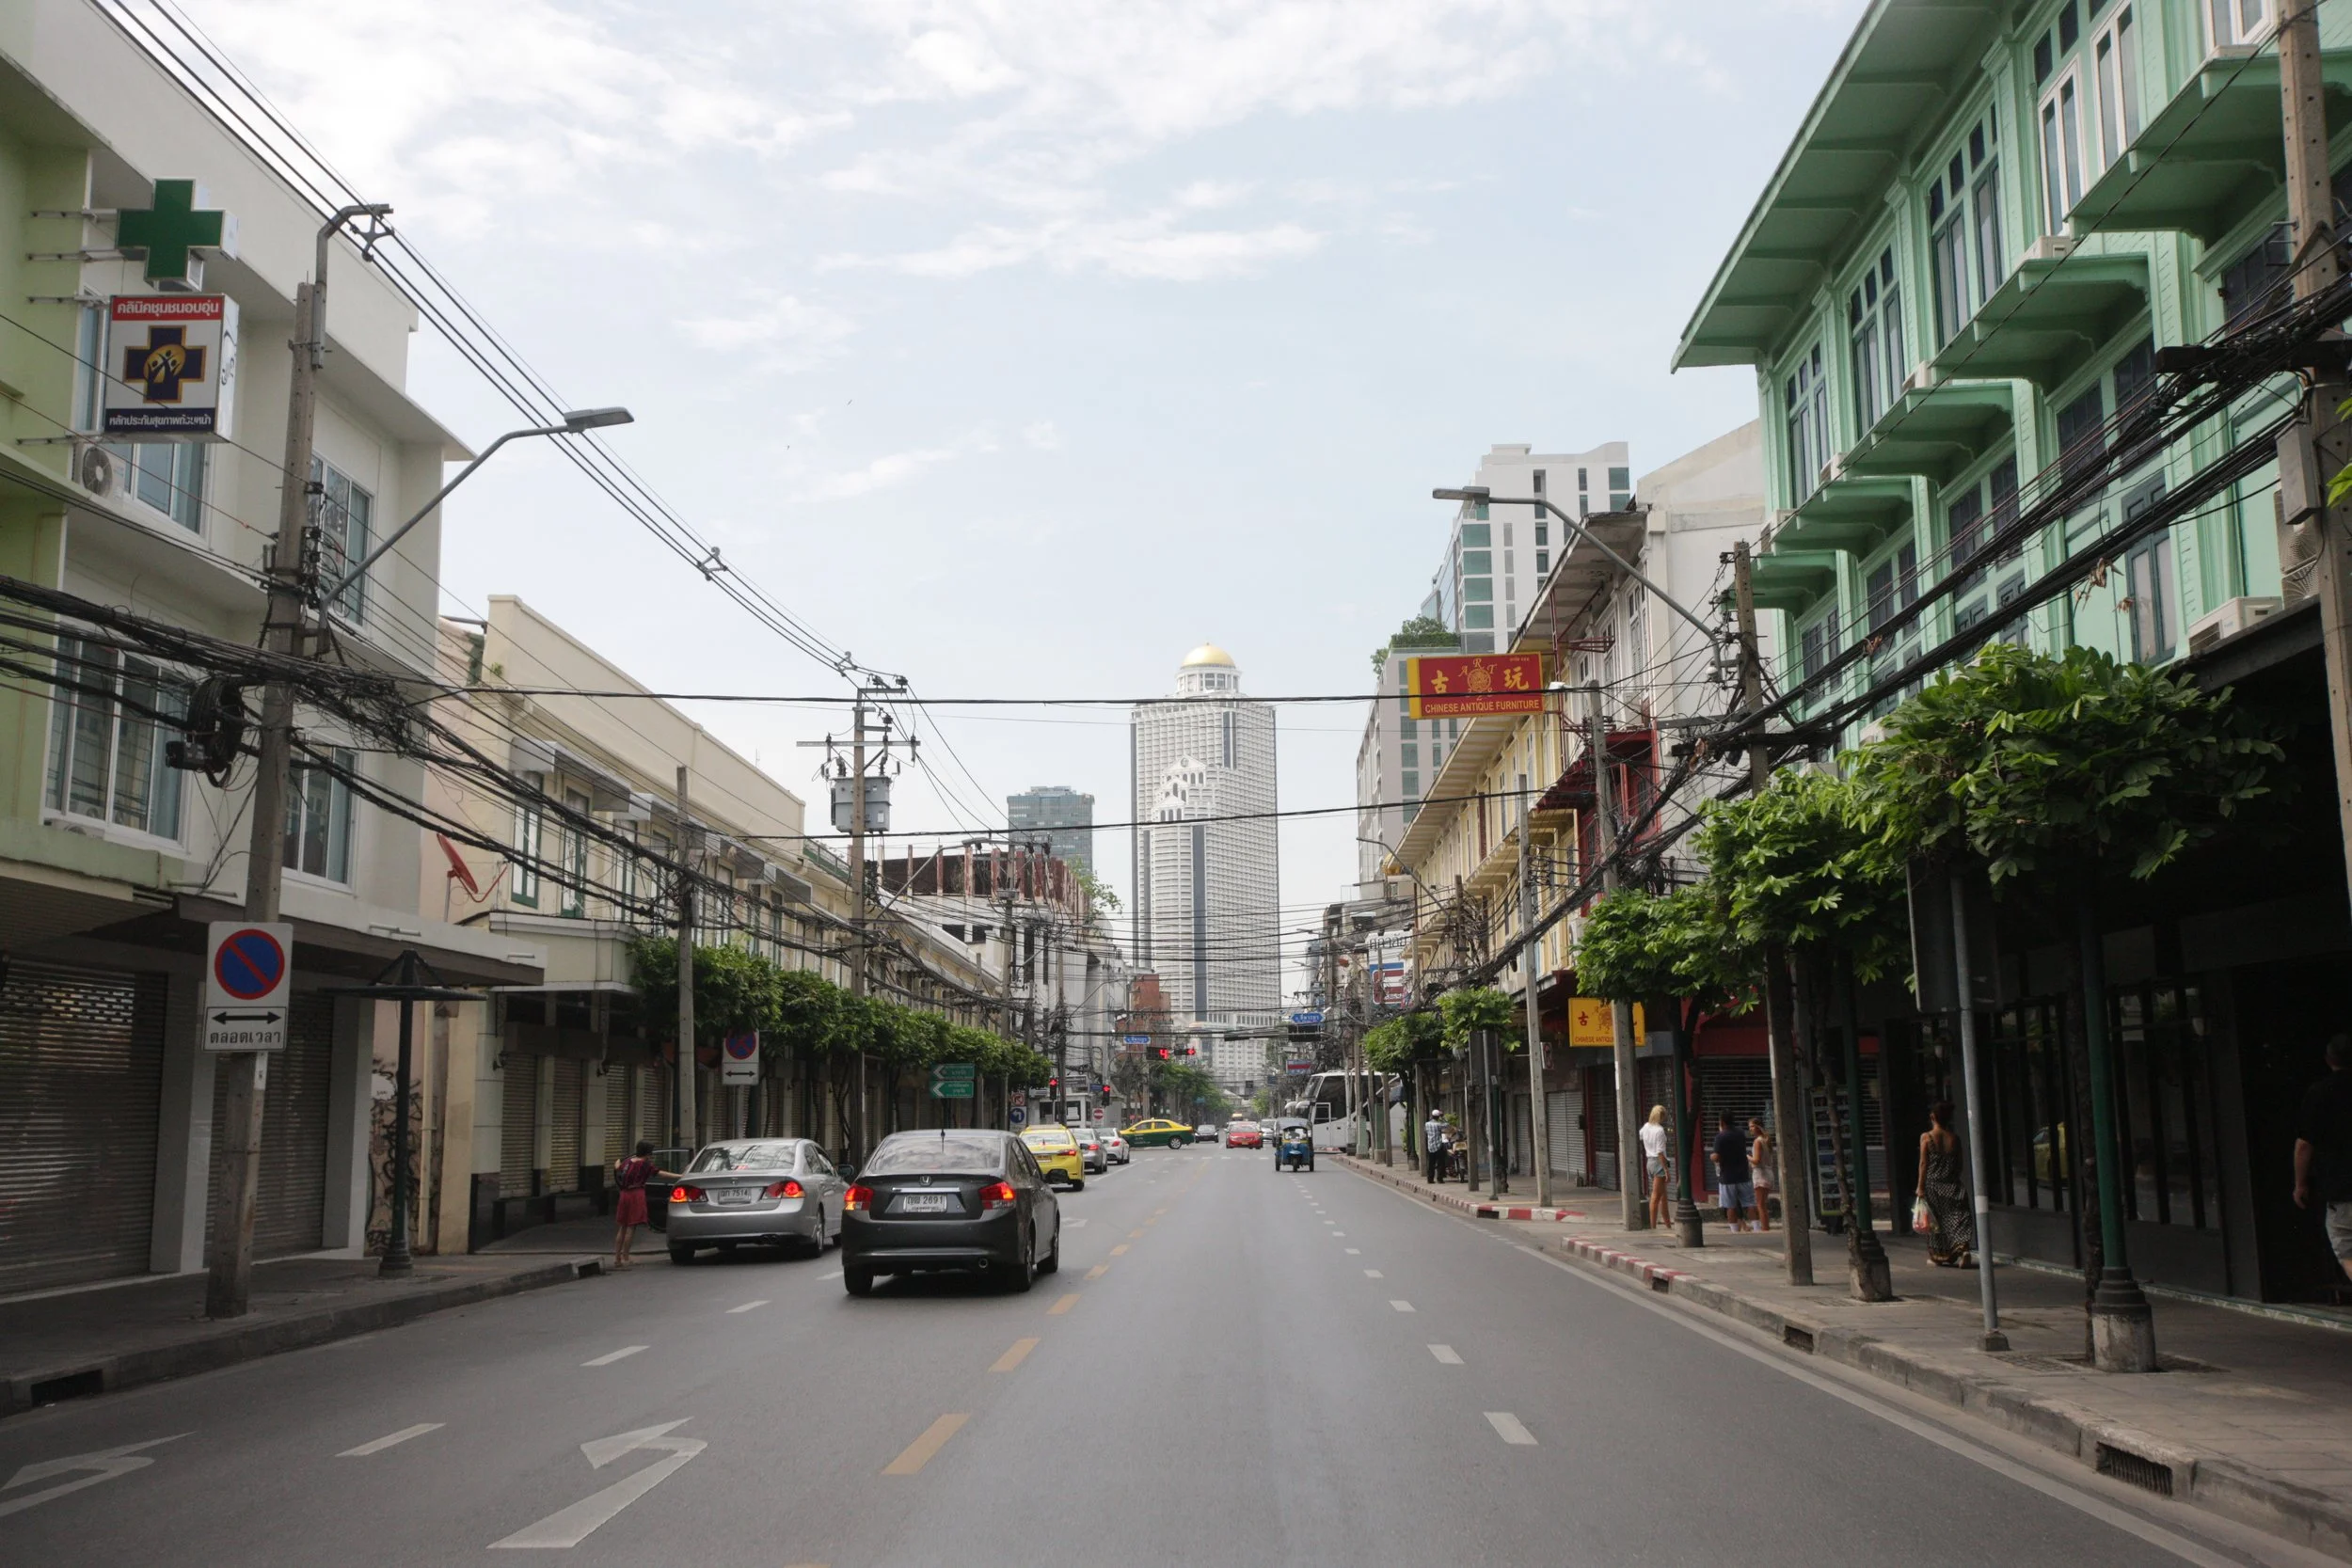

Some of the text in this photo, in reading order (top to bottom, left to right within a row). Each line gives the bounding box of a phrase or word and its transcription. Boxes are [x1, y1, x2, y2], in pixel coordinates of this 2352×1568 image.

[1431, 666, 1530, 694] 古 玩
[1424, 699, 1540, 714] CHINESE ANTIQUE FURNITURE
[210, 1031, 281, 1044] ตลอดเวลา
[923, 1196, 943, 1205] 2691
